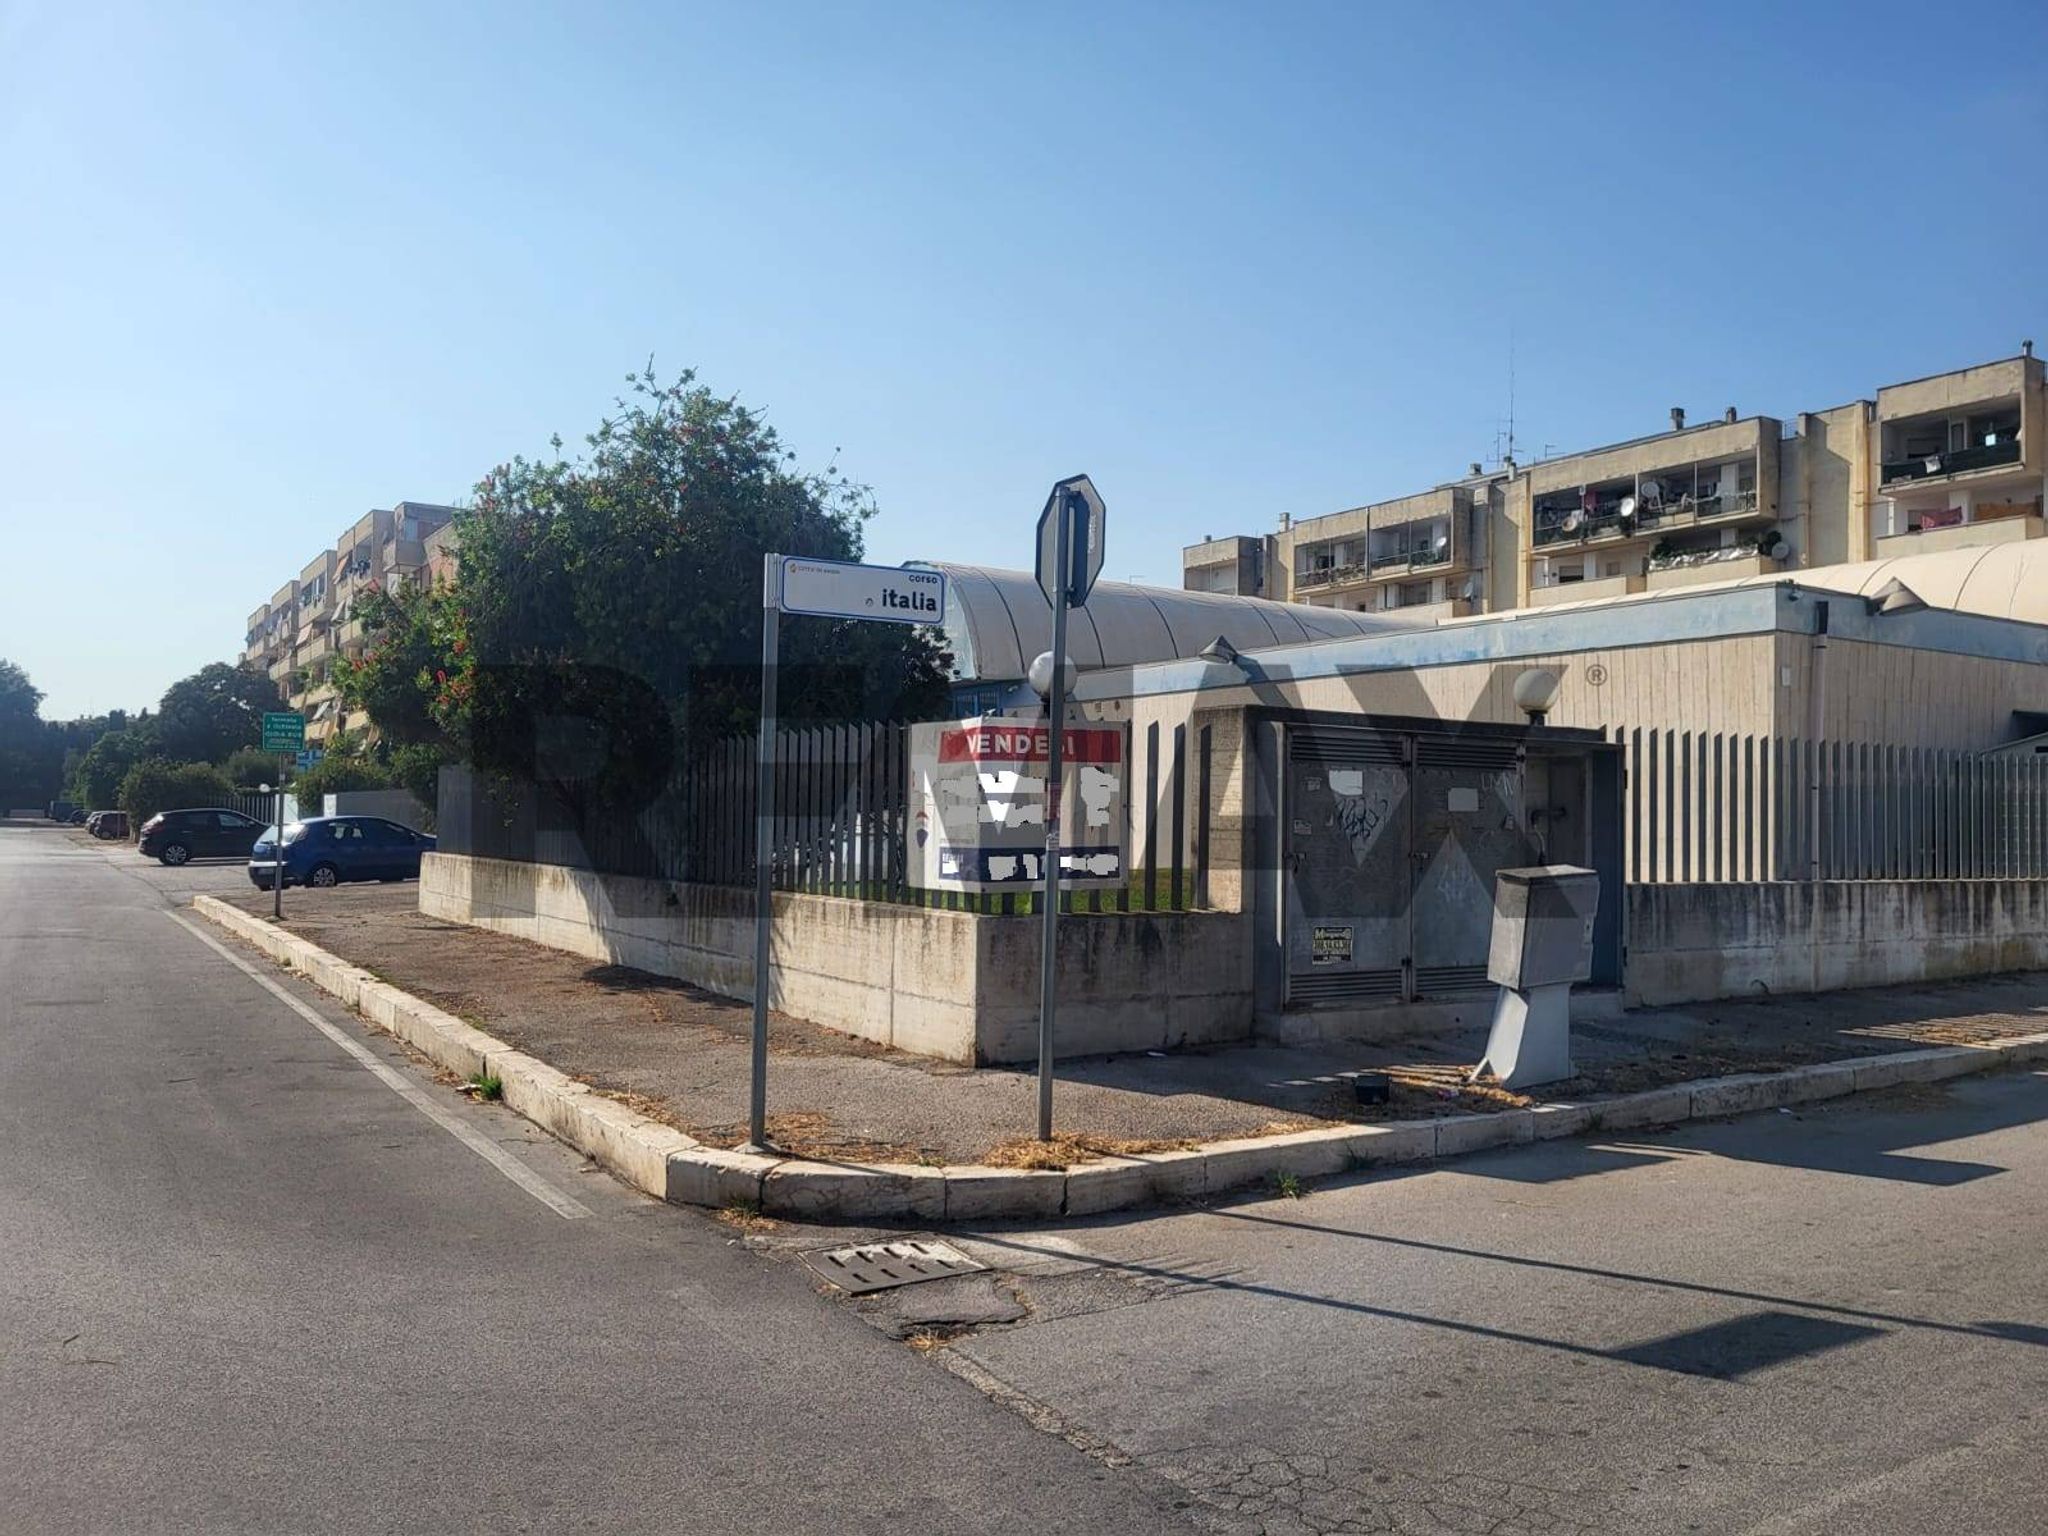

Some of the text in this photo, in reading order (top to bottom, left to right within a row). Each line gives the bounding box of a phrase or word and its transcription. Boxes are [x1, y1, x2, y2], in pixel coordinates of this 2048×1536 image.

[908, 574, 938, 584] corso
[882, 589, 937, 611] italia
[966, 733, 1074, 755] VENDEI
